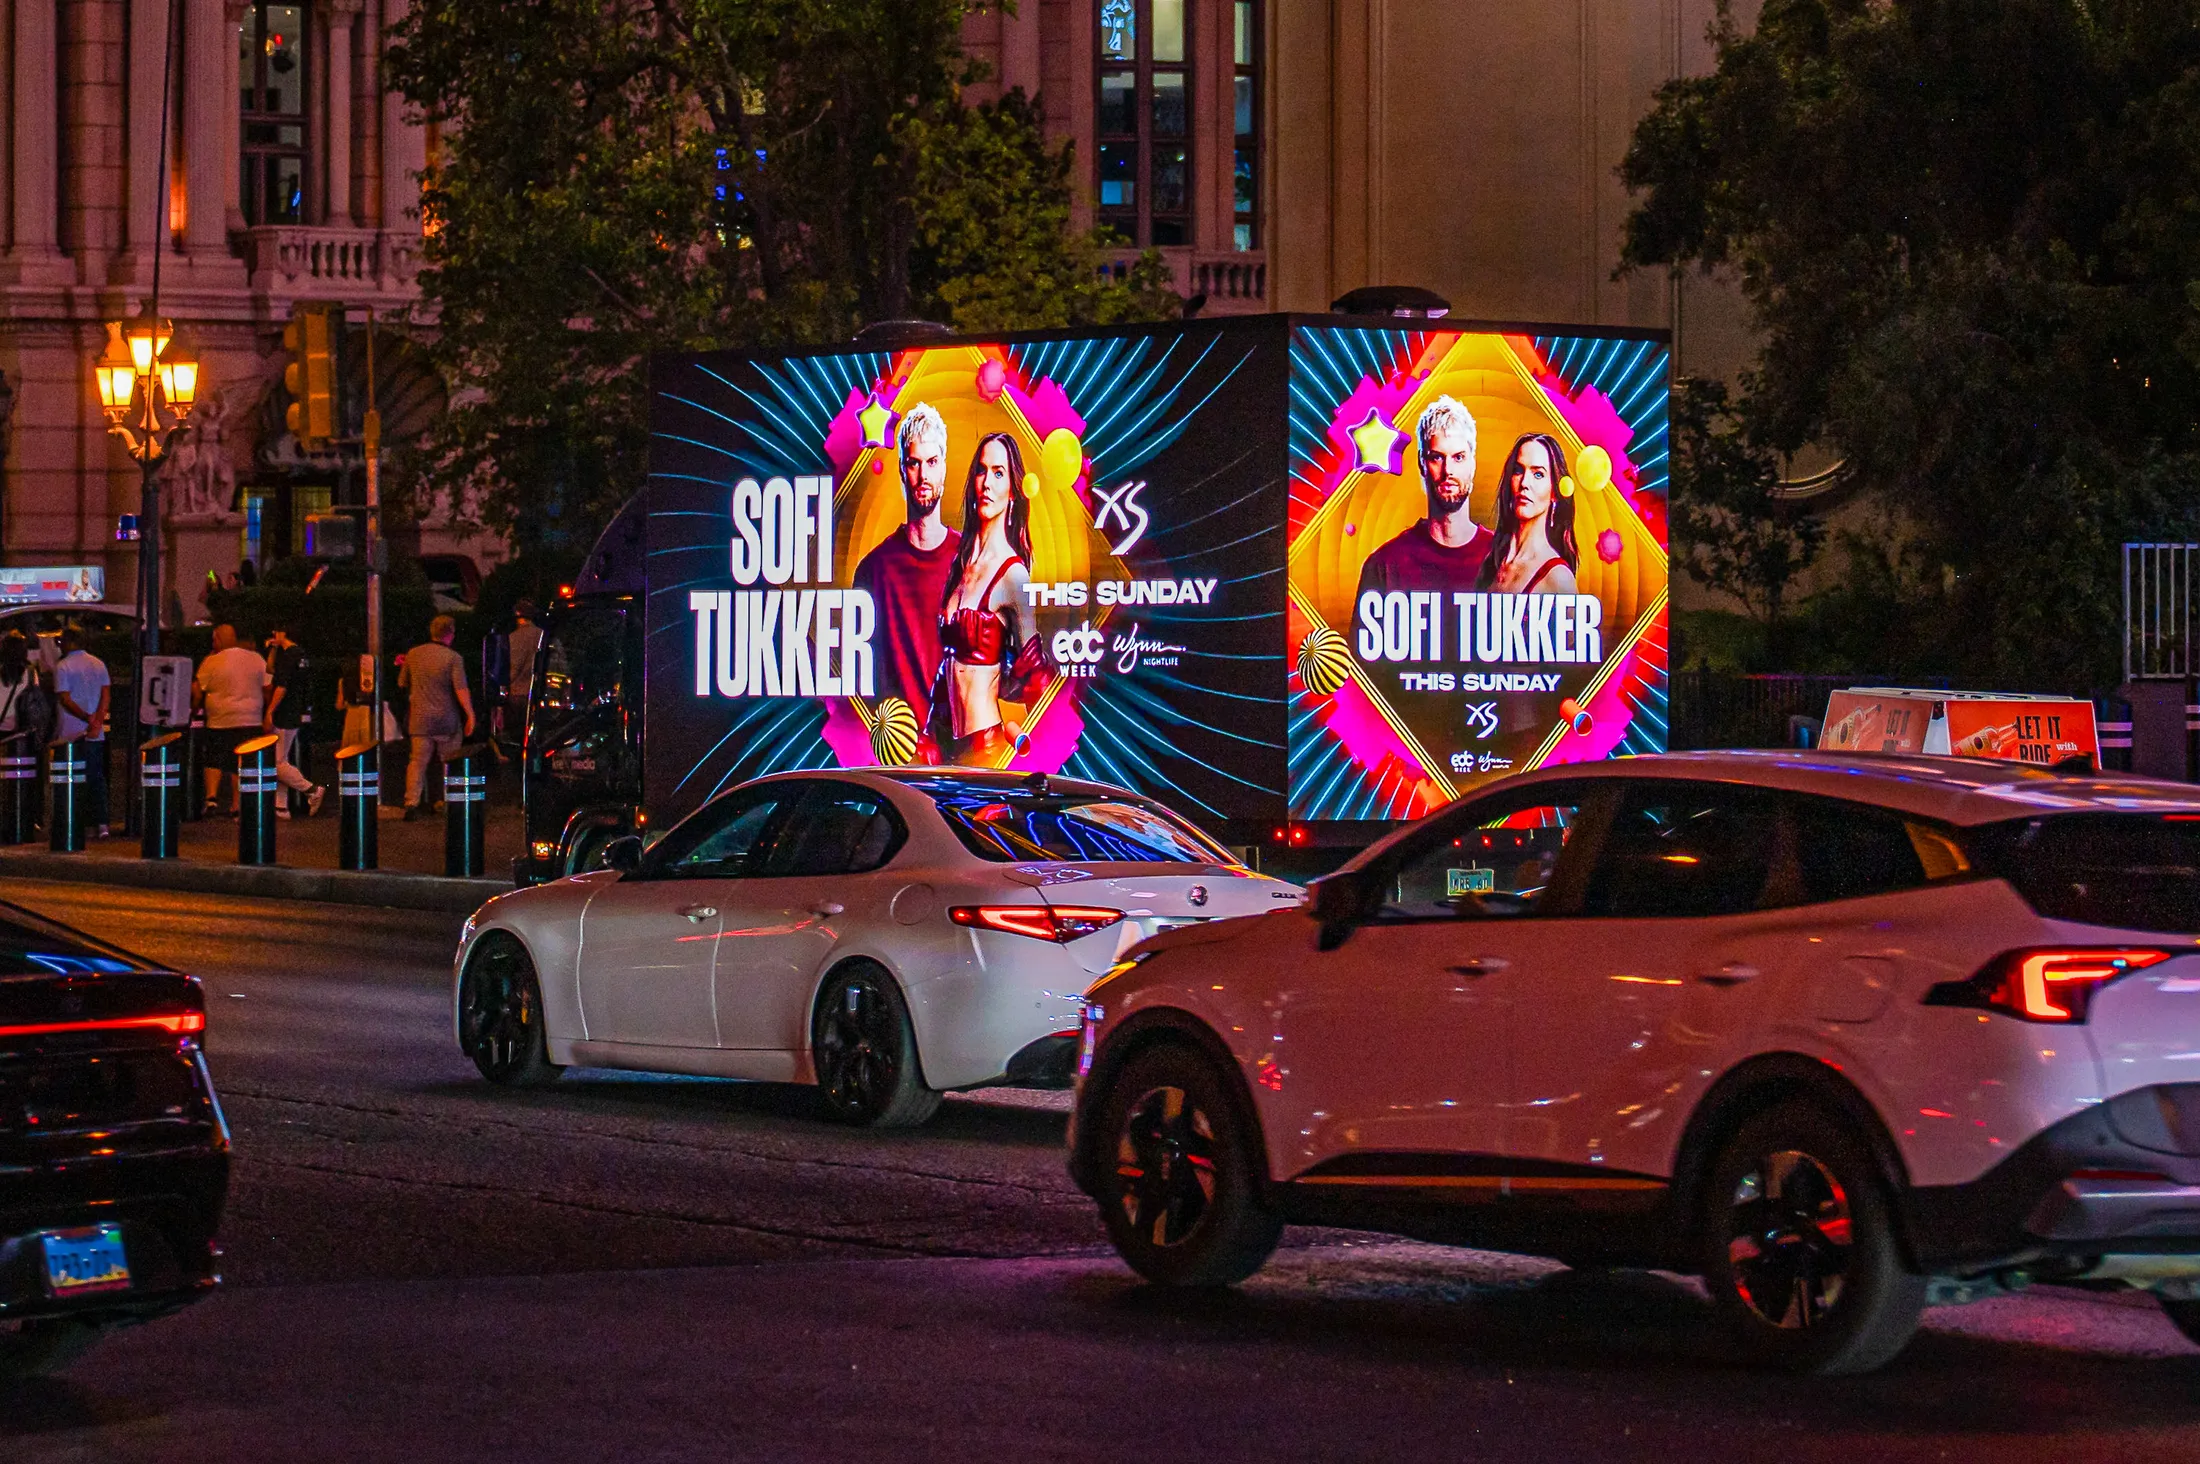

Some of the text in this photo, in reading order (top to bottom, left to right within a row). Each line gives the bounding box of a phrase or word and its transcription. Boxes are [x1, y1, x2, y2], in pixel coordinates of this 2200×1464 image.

[731, 475, 833, 584] SOFI
[1092, 481, 1148, 555] XS
[1023, 579, 1217, 606] THIS SUNDAY
[1052, 620, 1104, 662] edc
[1358, 591, 1602, 662] SOFI TUKKER
[689, 589, 876, 697] TUKKER
[1060, 665, 1097, 677] WEEK
[1143, 657, 1179, 666] NIGHTLIFE
[1400, 673, 1562, 691] THIS SUNDAY
[1465, 702, 1498, 738] XS
[2016, 716, 2061, 739] LET IT
[2056, 742, 2078, 750] with
